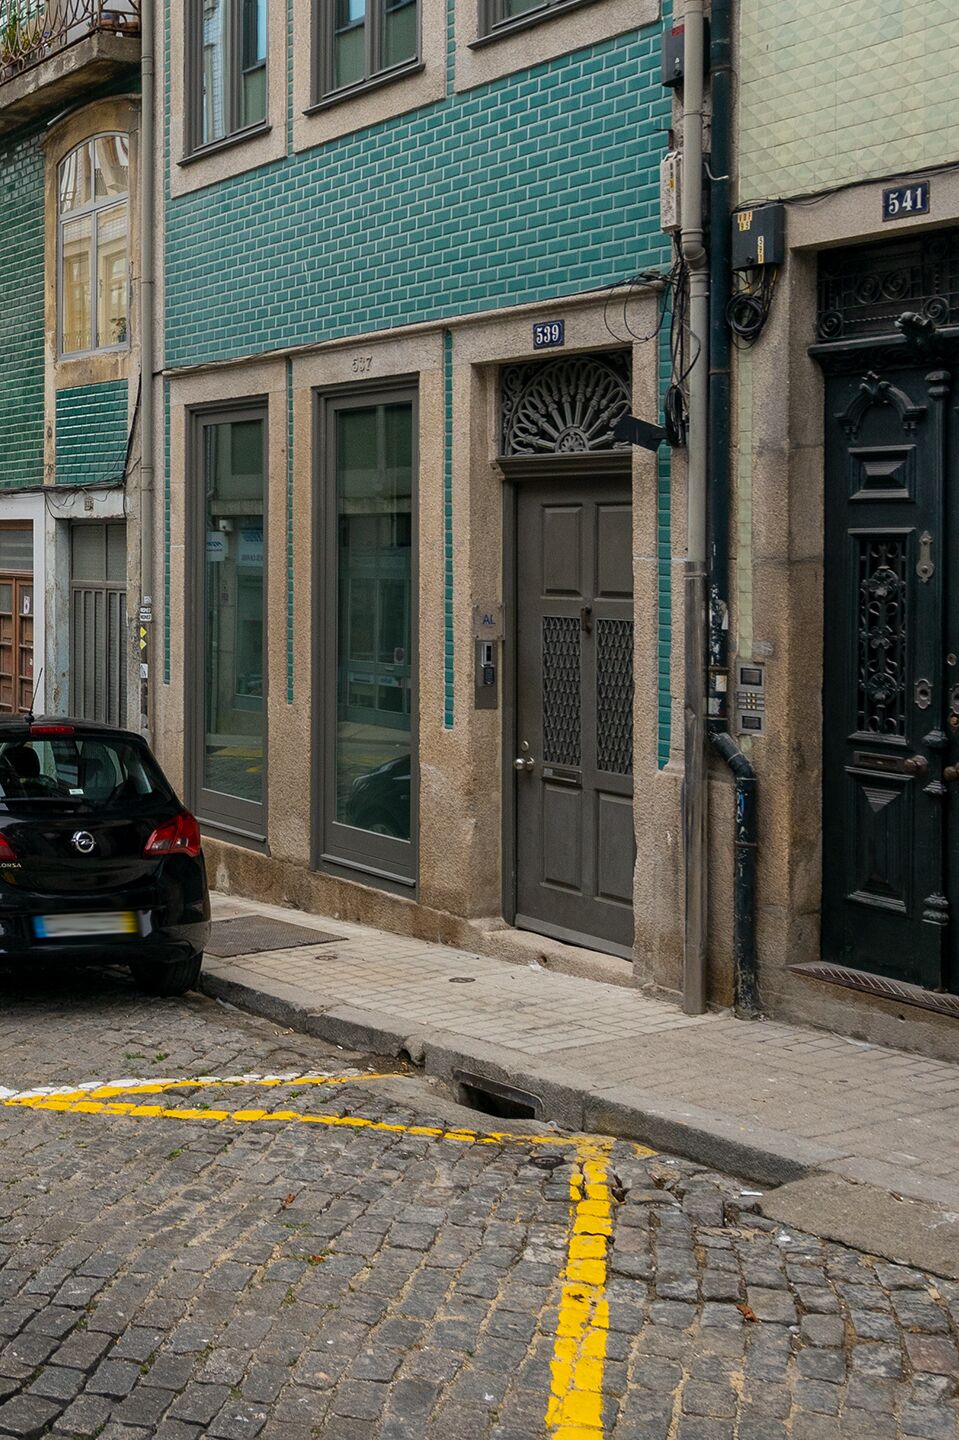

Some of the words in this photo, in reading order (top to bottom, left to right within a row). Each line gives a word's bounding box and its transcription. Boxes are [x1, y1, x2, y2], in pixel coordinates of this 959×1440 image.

[888, 187, 923, 214] 541
[536, 324, 559, 344] 539
[482, 614, 496, 625] AL
